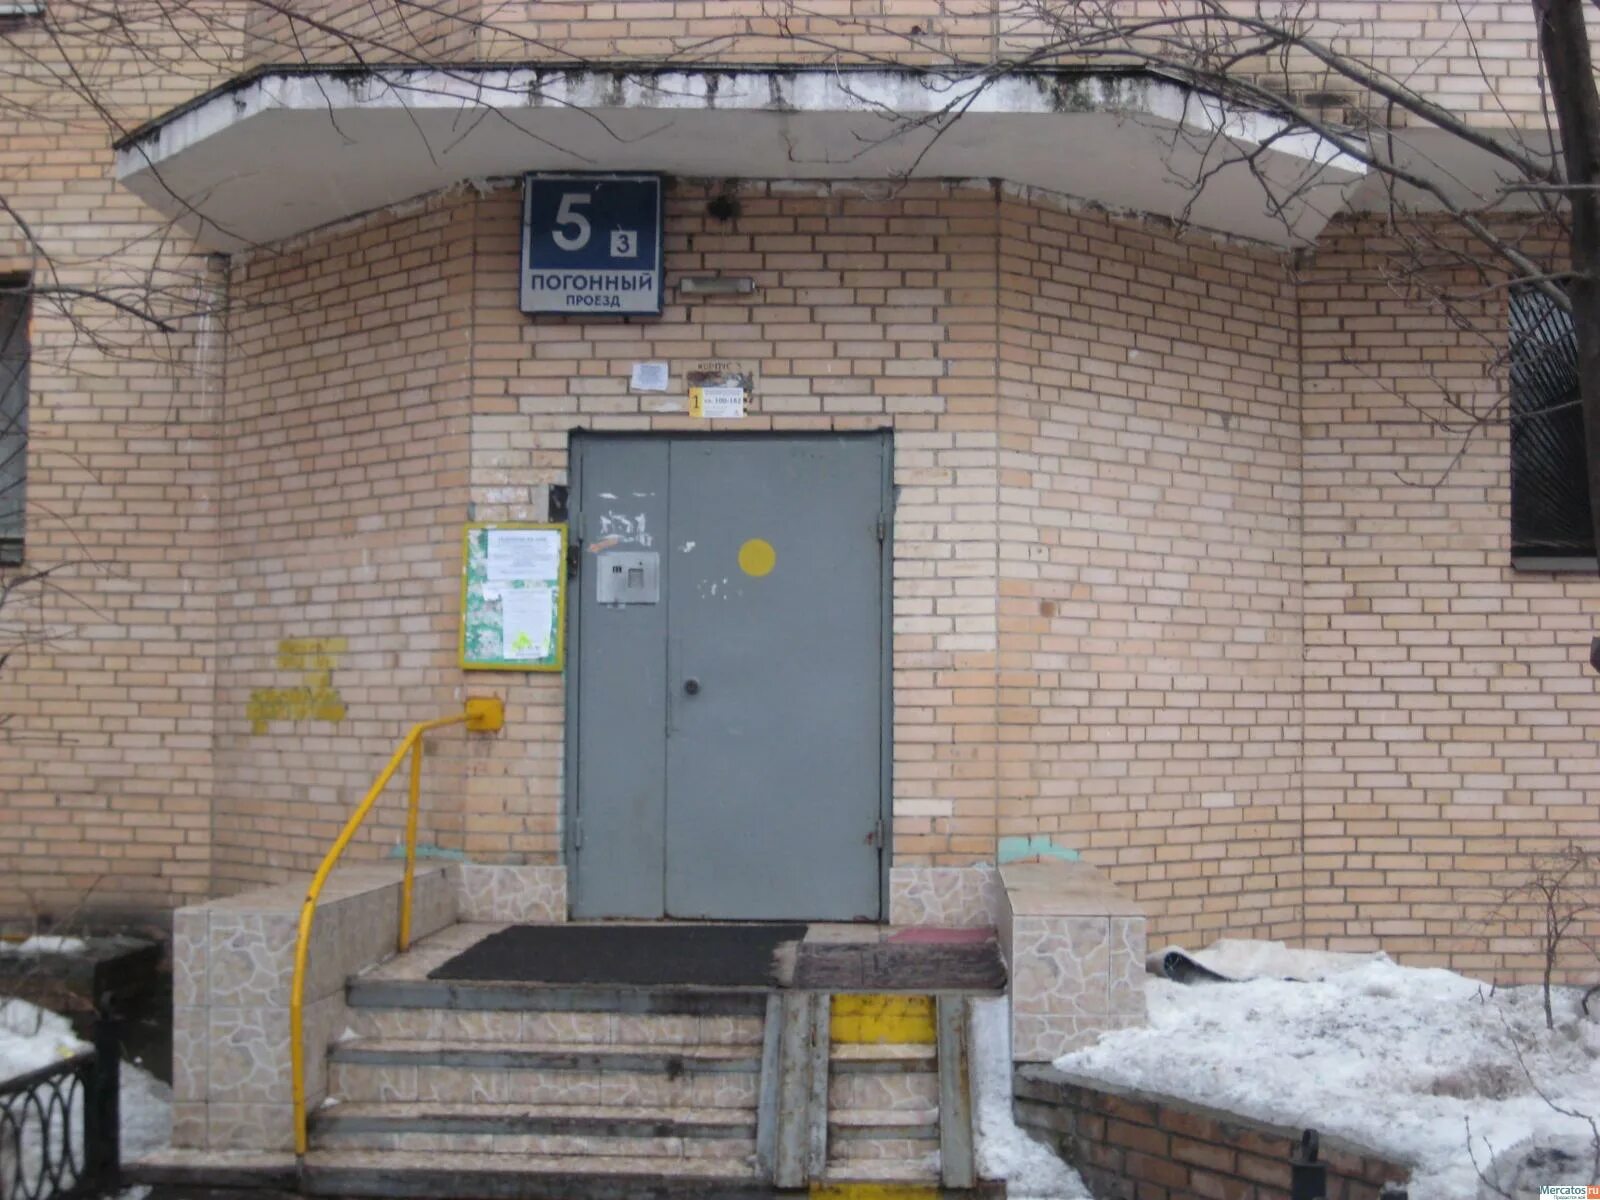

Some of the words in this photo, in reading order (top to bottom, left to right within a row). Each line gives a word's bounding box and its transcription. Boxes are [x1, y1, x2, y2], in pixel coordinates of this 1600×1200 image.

[552, 193, 591, 251] 5
[617, 234, 630, 253] 3
[531, 272, 652, 290] ПОГОННЫЙ
[566, 295, 620, 308] ПРОЕЗД
